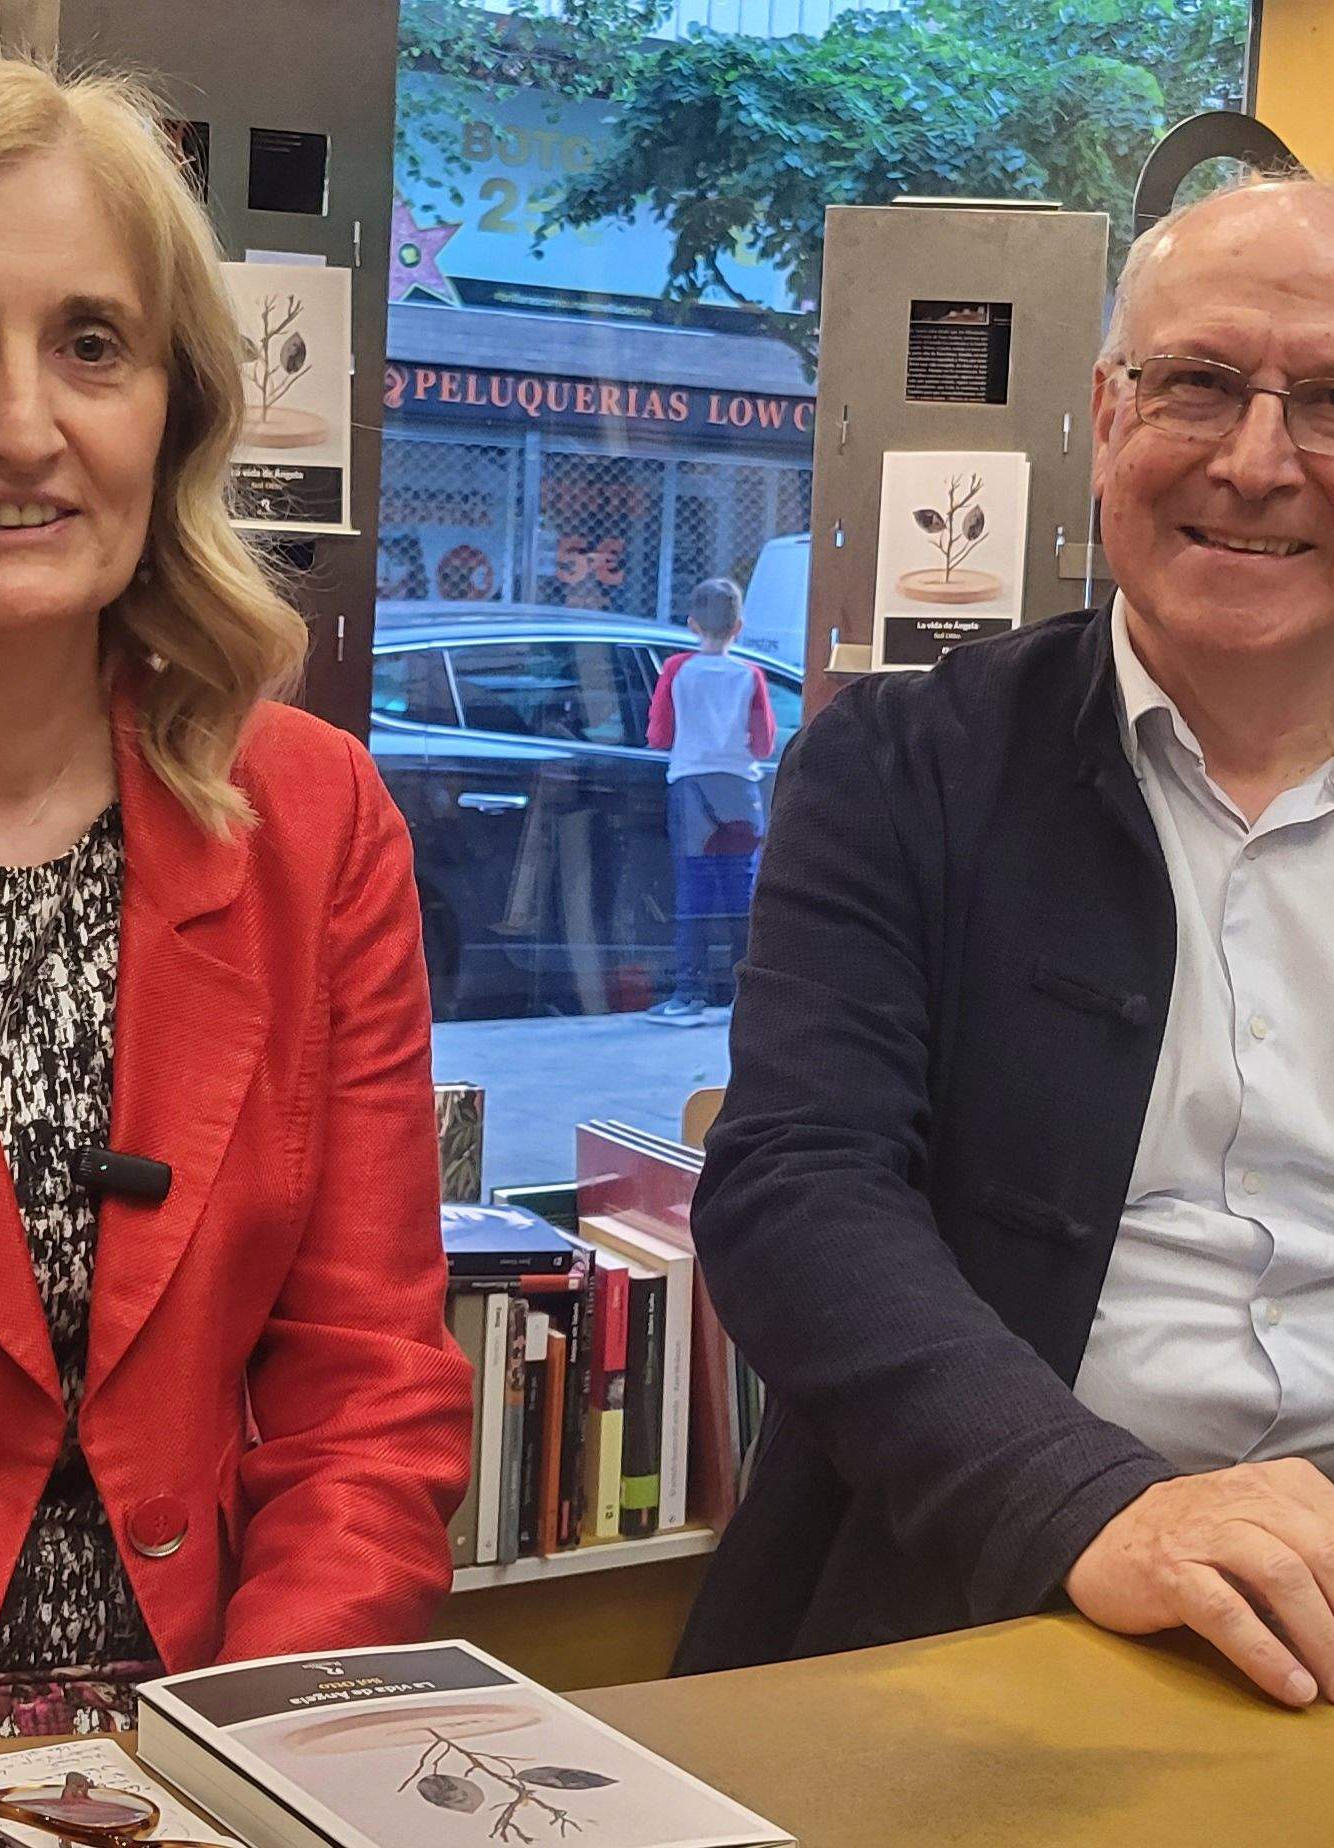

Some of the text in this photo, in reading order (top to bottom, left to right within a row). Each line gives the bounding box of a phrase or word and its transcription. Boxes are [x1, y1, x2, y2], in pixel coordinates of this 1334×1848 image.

[413, 367, 690, 422] PELUQUERIAS
[707, 393, 788, 428] LOW
[288, 1680, 436, 1705] La vida de Ángela
[318, 1677, 384, 1690] Sol Otto
